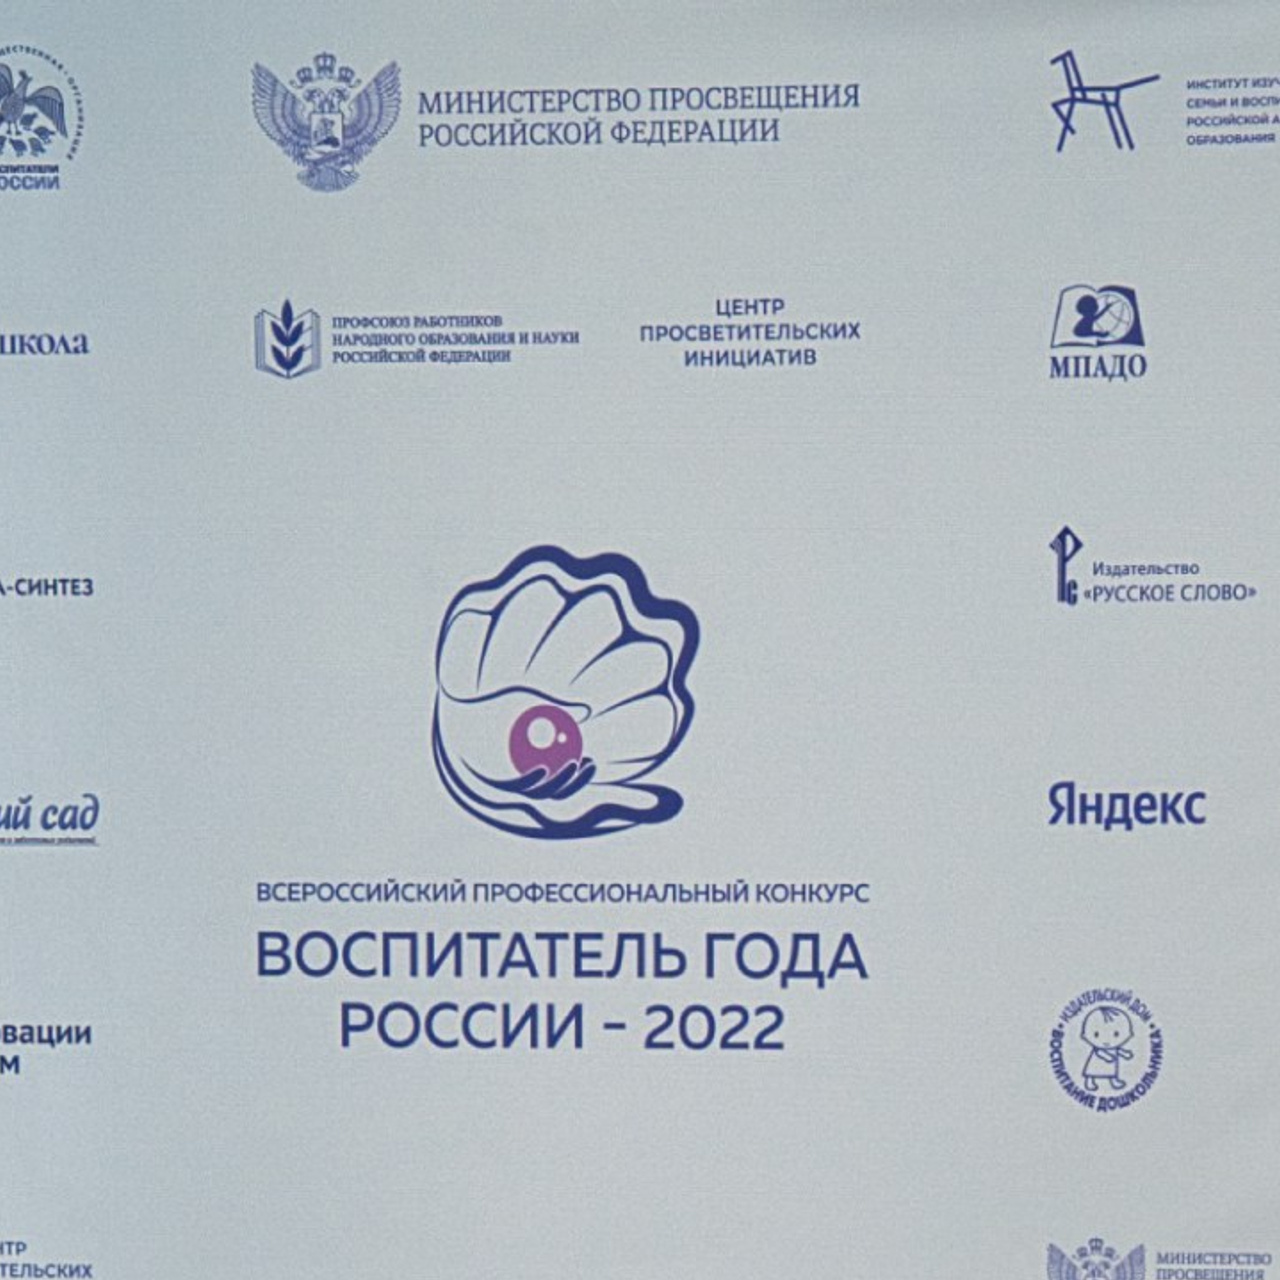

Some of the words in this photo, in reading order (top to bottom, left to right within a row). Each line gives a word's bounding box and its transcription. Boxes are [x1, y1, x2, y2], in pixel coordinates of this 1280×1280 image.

[1186, 77, 1250, 90] ИНСТИТУТ
[418, 87, 642, 115] МИНИСТЕРСТВО
[648, 83, 860, 112] ПРОСВЕЩЕНИЯ
[1185, 97, 1228, 110] СЕМЬИ
[1229, 97, 1239, 108] И
[418, 112, 603, 148] РОССИЙСКОЙ
[610, 117, 780, 147] ФЕДЕРАЦИИ
[1186, 113, 1270, 128] РОССИЙСКОЙ
[1185, 132, 1276, 146] ОБРАЗОВАНИЯ
[715, 297, 785, 319] ЦЕНТР
[331, 316, 411, 329] ПРОФСОЮЗ
[413, 315, 503, 329] РАБОТНИКОВ
[640, 321, 861, 342] ПРОСВЕТИТЕЛЬСКИХ
[332, 332, 416, 347] НАРОДНОГО
[417, 331, 516, 346] ОБРАЗОВАНИЯ
[518, 331, 530, 345] И
[532, 331, 580, 345] НАУКИ
[332, 347, 426, 364] РОССИЙСКОЙ
[428, 349, 512, 365] ФЕДЕРАЦИИ
[684, 348, 817, 369] ИНИЦИАТИВ
[1049, 353, 1148, 382] МПАДО
[1092, 561, 1200, 578] Издательство
[1083, 583, 1175, 603] «РУССКОЕ
[1180, 583, 1257, 602] СЛОВО»
[40, 792, 100, 831] сад
[1048, 780, 1207, 832] Яндекс
[256, 878, 466, 903] ВСЕРОССИЙСКИЙ
[472, 878, 749, 904] ПРОФЕССИОНАЛЬНЫЙ
[755, 883, 870, 904] КОНКУРС
[257, 930, 687, 979] ВОСПИТАТЕЛЬ
[705, 931, 869, 990] ГОДА
[0, 1024, 92, 1048] вации
[341, 1001, 583, 1049] РОССИИ
[644, 1004, 785, 1051] 2022
[1156, 1251, 1273, 1266] МИНИСТЕРСТВО
